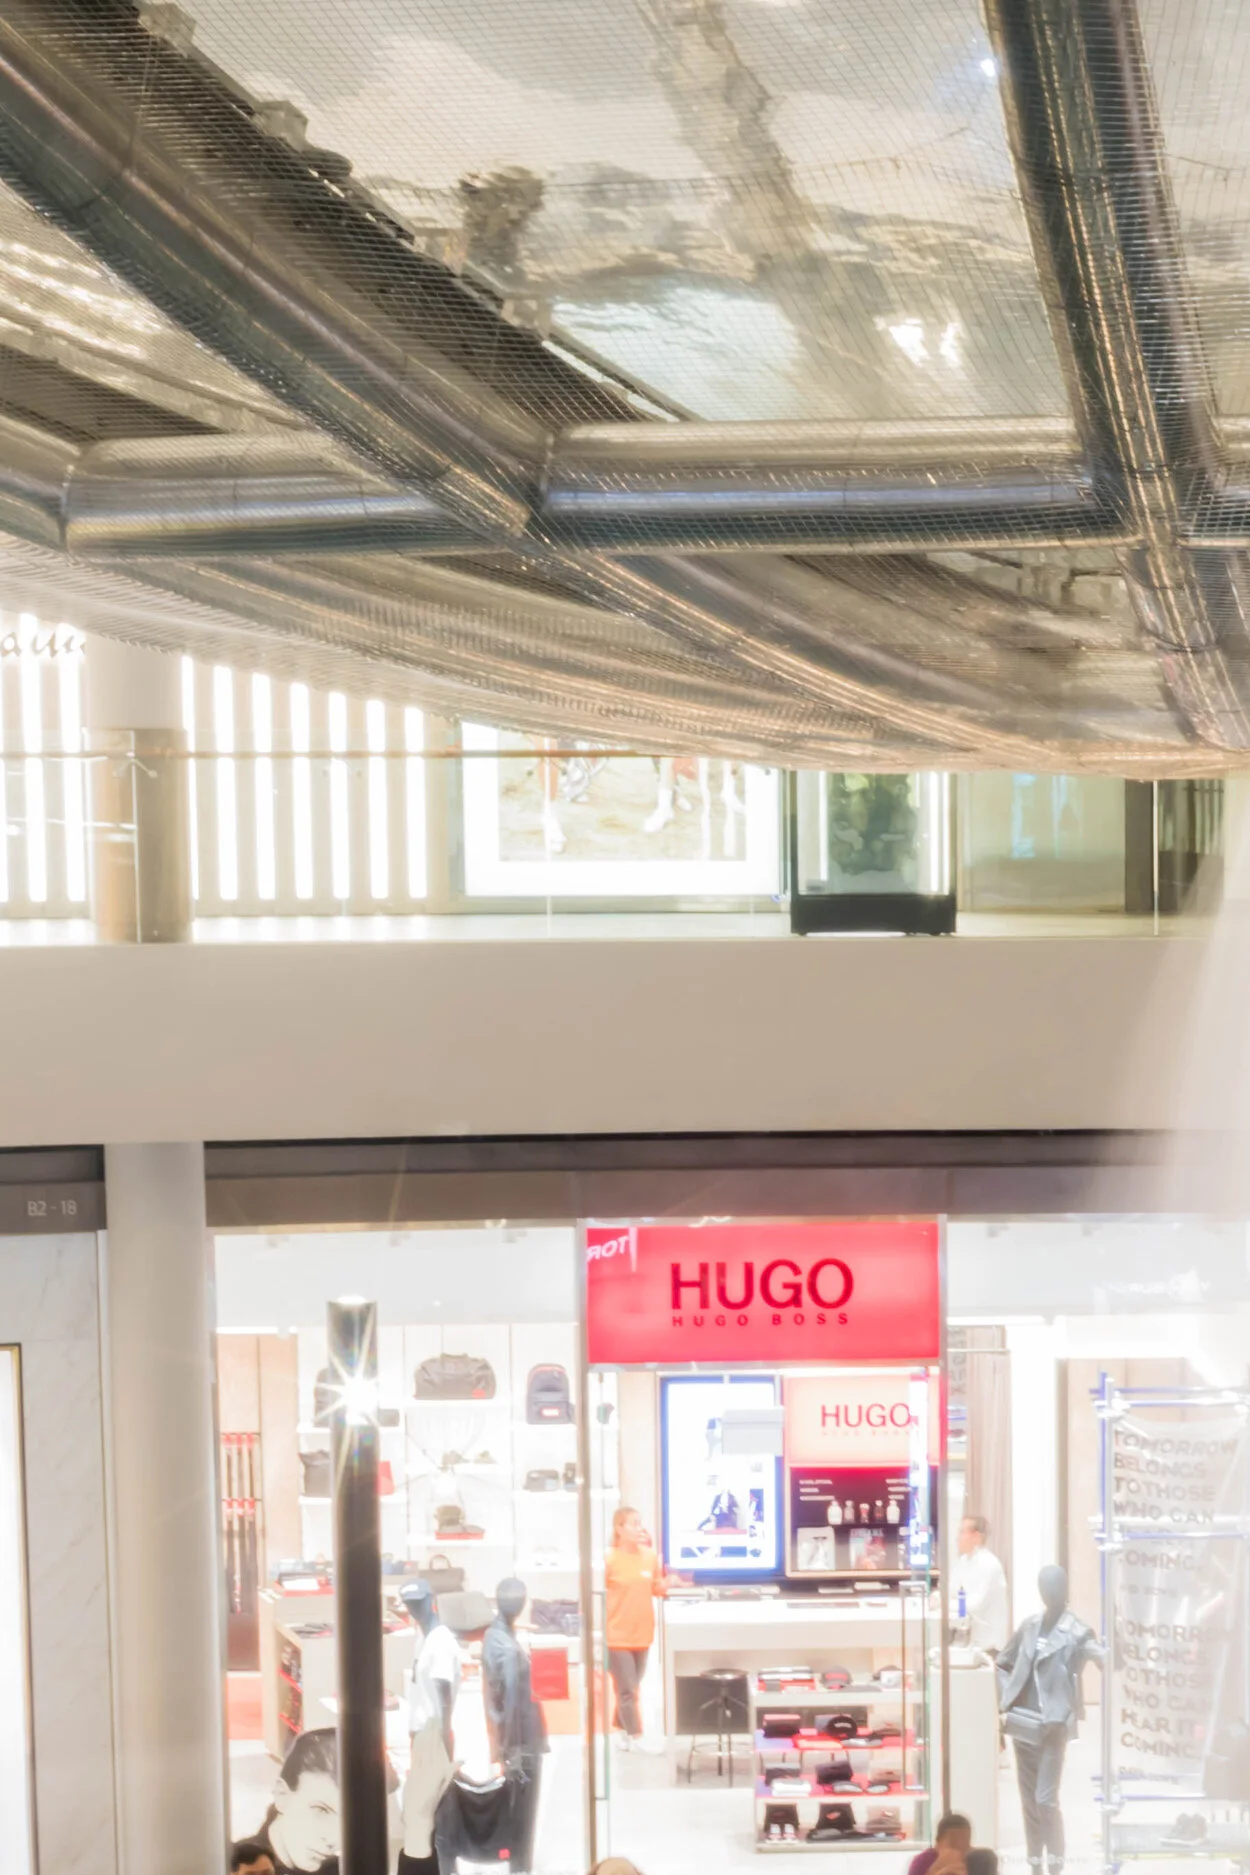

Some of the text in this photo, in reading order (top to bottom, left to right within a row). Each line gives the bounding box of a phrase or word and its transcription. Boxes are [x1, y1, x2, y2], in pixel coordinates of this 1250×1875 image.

[670, 1258, 854, 1310] HUGO
[672, 1313, 849, 1328] HUGO BOSS
[821, 1403, 911, 1428] HUGO
